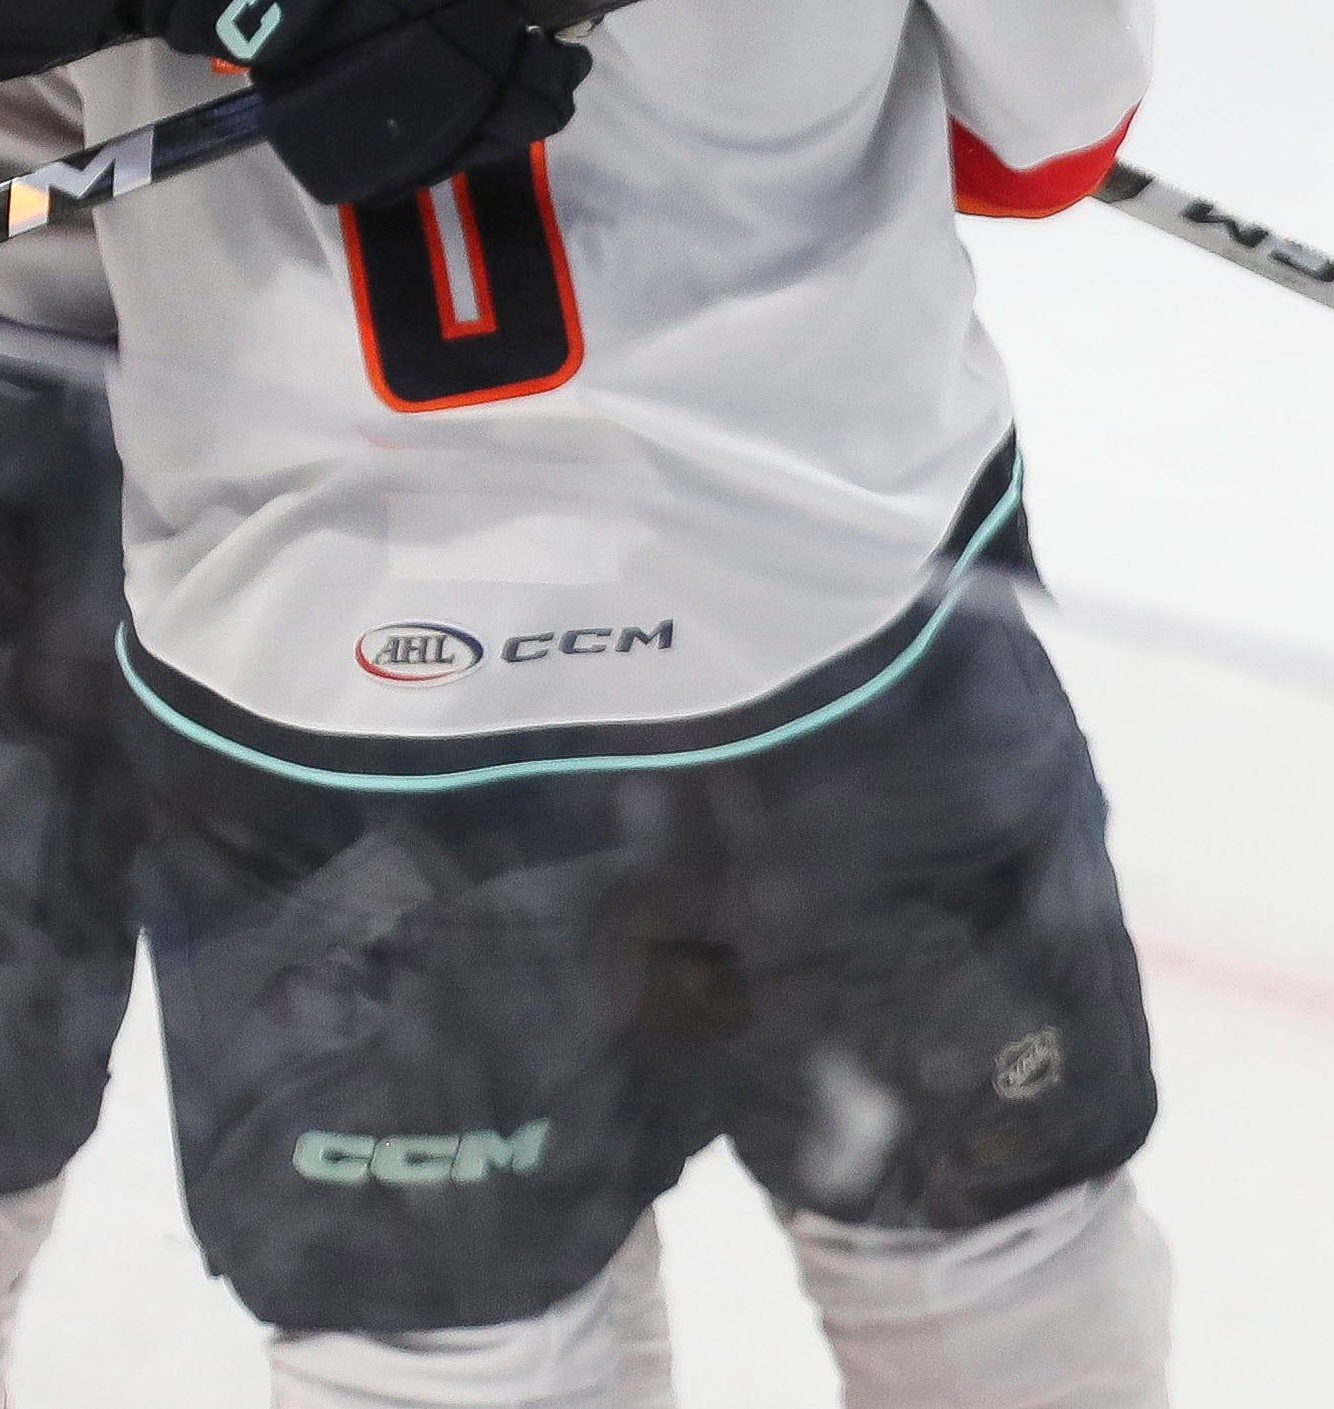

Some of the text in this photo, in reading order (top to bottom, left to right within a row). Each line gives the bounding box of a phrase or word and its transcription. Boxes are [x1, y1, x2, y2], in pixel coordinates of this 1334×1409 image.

[374, 618, 674, 665] AHL CCM
[292, 1116, 551, 1184] CCM
